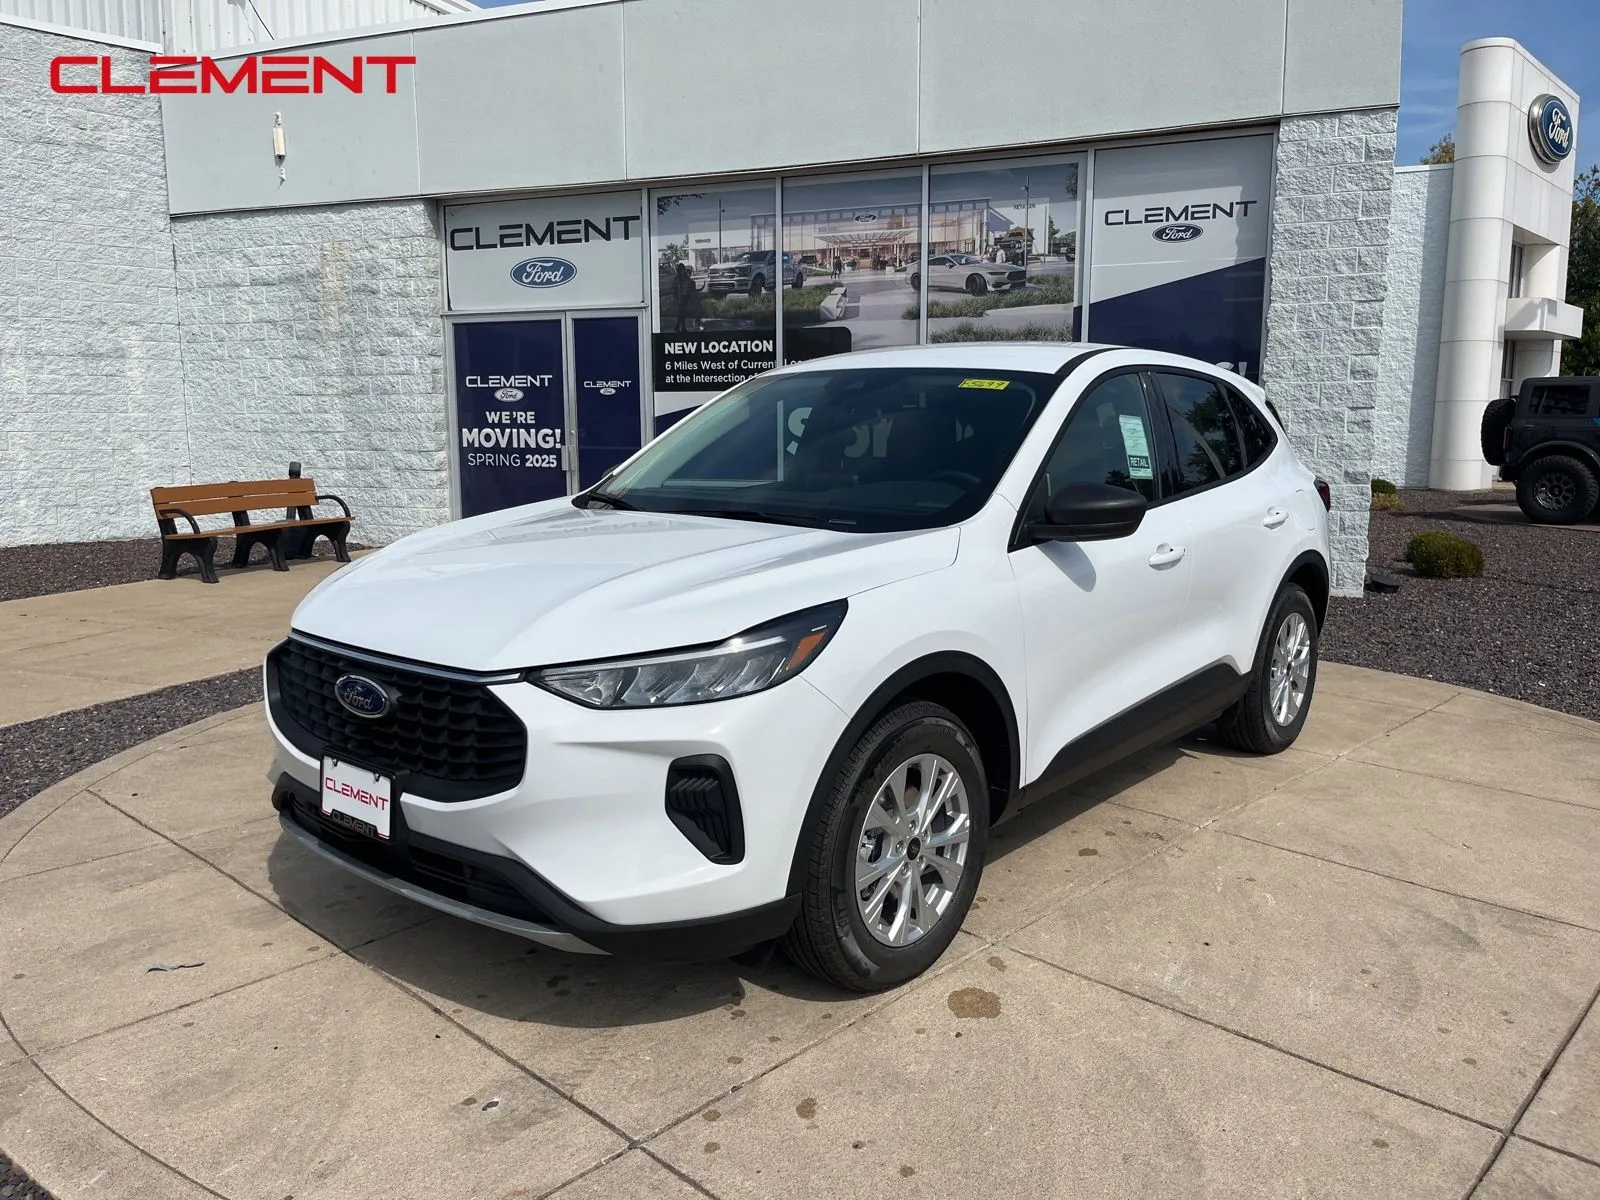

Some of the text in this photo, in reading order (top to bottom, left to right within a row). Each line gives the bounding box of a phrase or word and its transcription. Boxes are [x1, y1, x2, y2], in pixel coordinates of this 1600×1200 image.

[1548, 107, 1570, 149] Ford
[1104, 200, 1258, 226] CLEMENT
[450, 215, 640, 251] CLEMENT
[1162, 226, 1193, 240] Ford
[522, 261, 564, 284] Ford
[664, 340, 774, 355] NEW LOCATION
[665, 362, 672, 370] 6
[674, 361, 698, 370] Miles
[701, 360, 725, 370] West
[728, 359, 739, 369] of
[465, 375, 553, 387] CLEMENT
[665, 374, 674, 383] at
[677, 373, 690, 383] the
[693, 373, 745, 384] Intersection
[486, 411, 536, 424] WE'RE
[462, 428, 561, 449] MOVING!
[468, 453, 557, 468] SPRING 2025
[1130, 457, 1149, 468] RETAIL
[344, 685, 373, 710] Ford
[325, 776, 388, 811] CLEMENT
[332, 812, 376, 838] CLEMENT
